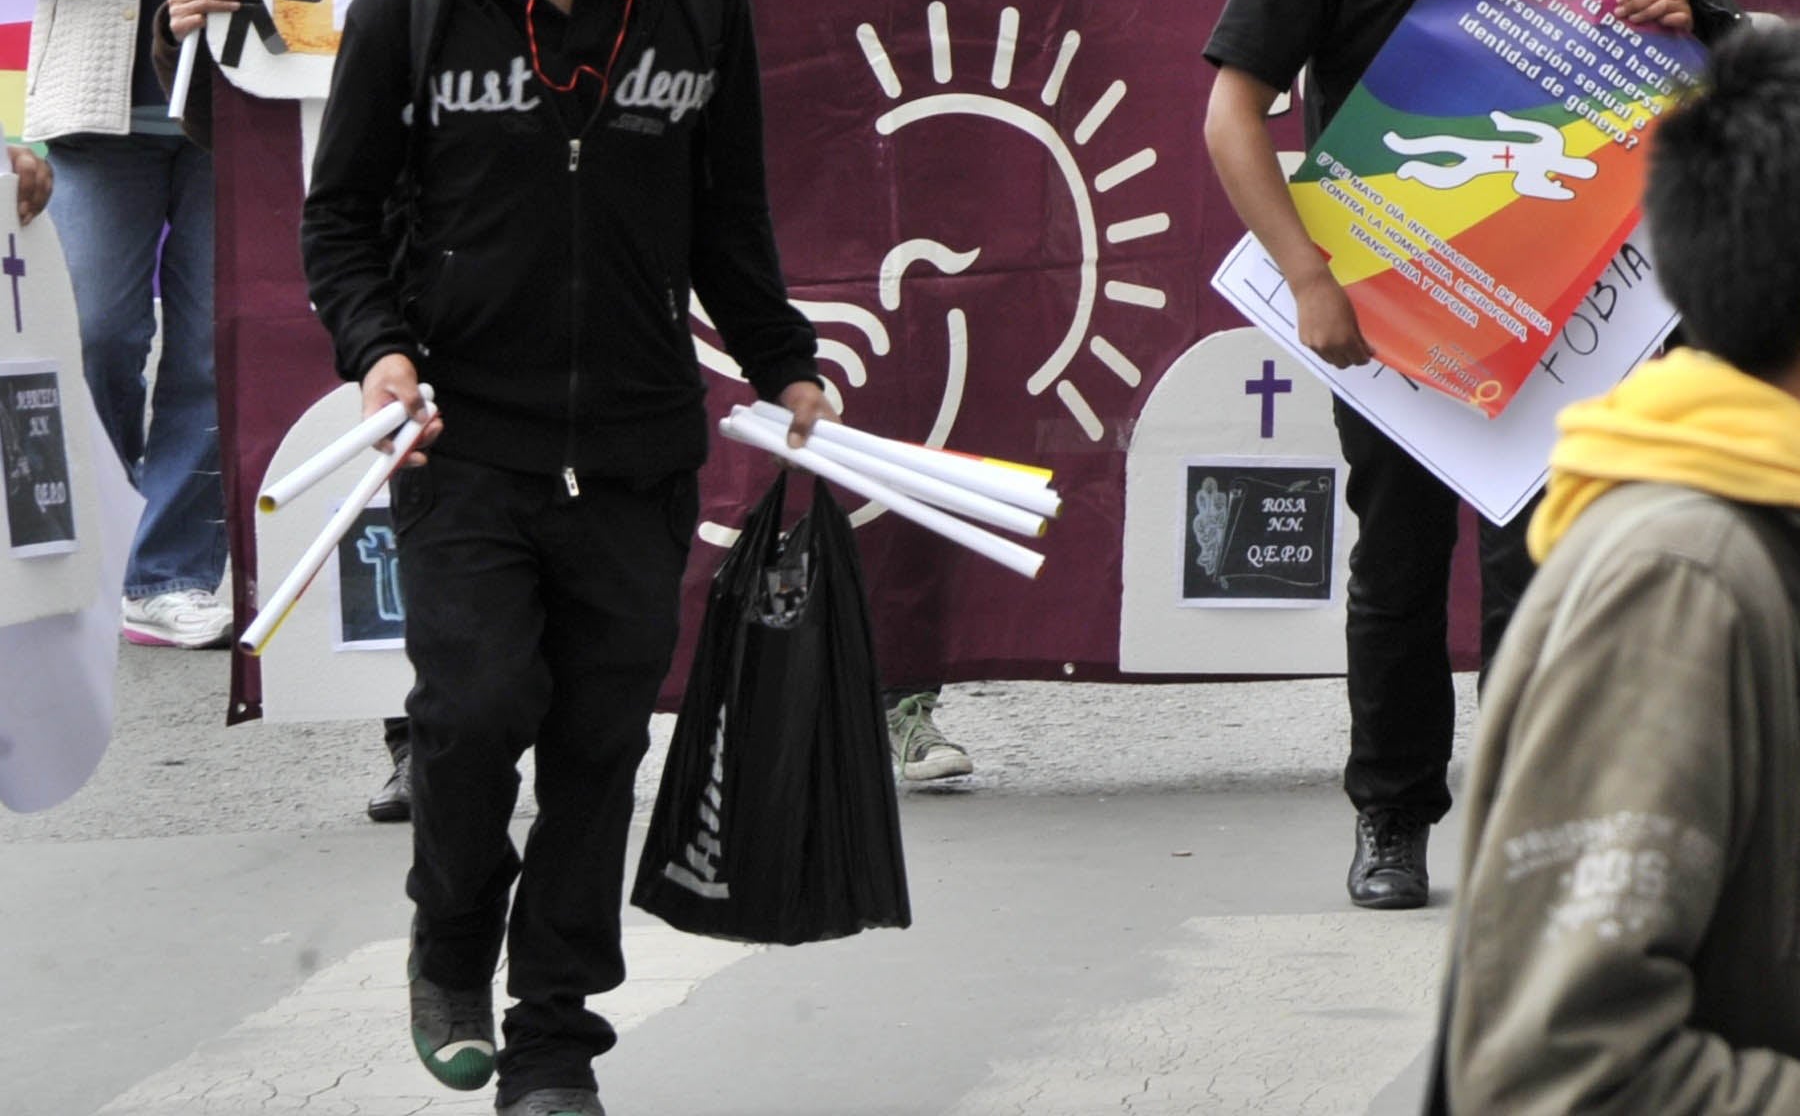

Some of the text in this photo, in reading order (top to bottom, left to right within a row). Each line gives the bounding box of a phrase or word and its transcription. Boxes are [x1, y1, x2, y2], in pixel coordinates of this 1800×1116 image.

[1600, 10, 1643, 49] para
[1457, 12, 1639, 151] identidad de género?
[1475, 0, 1647, 131] orientación sexual e
[1564, 39, 1598, 68] con
[1598, 60, 1664, 117] diversa
[1625, 53, 1673, 97] hacia
[1318, 177, 1367, 220] CONTRA
[1366, 211, 1384, 233] LA
[1329, 159, 1353, 182] DE
[1350, 176, 1386, 208] MAYO
[1384, 200, 1407, 225] DÍA
[1406, 218, 1496, 294] INTERNACIONAL
[1493, 283, 1516, 308] DE
[1513, 295, 1553, 337] LUCHA
[1349, 222, 1481, 329] TRANSFOBIA Y BIFOBIA
[1261, 496, 1308, 514] ROSA
[1246, 544, 1314, 569] Q.E.P.D
